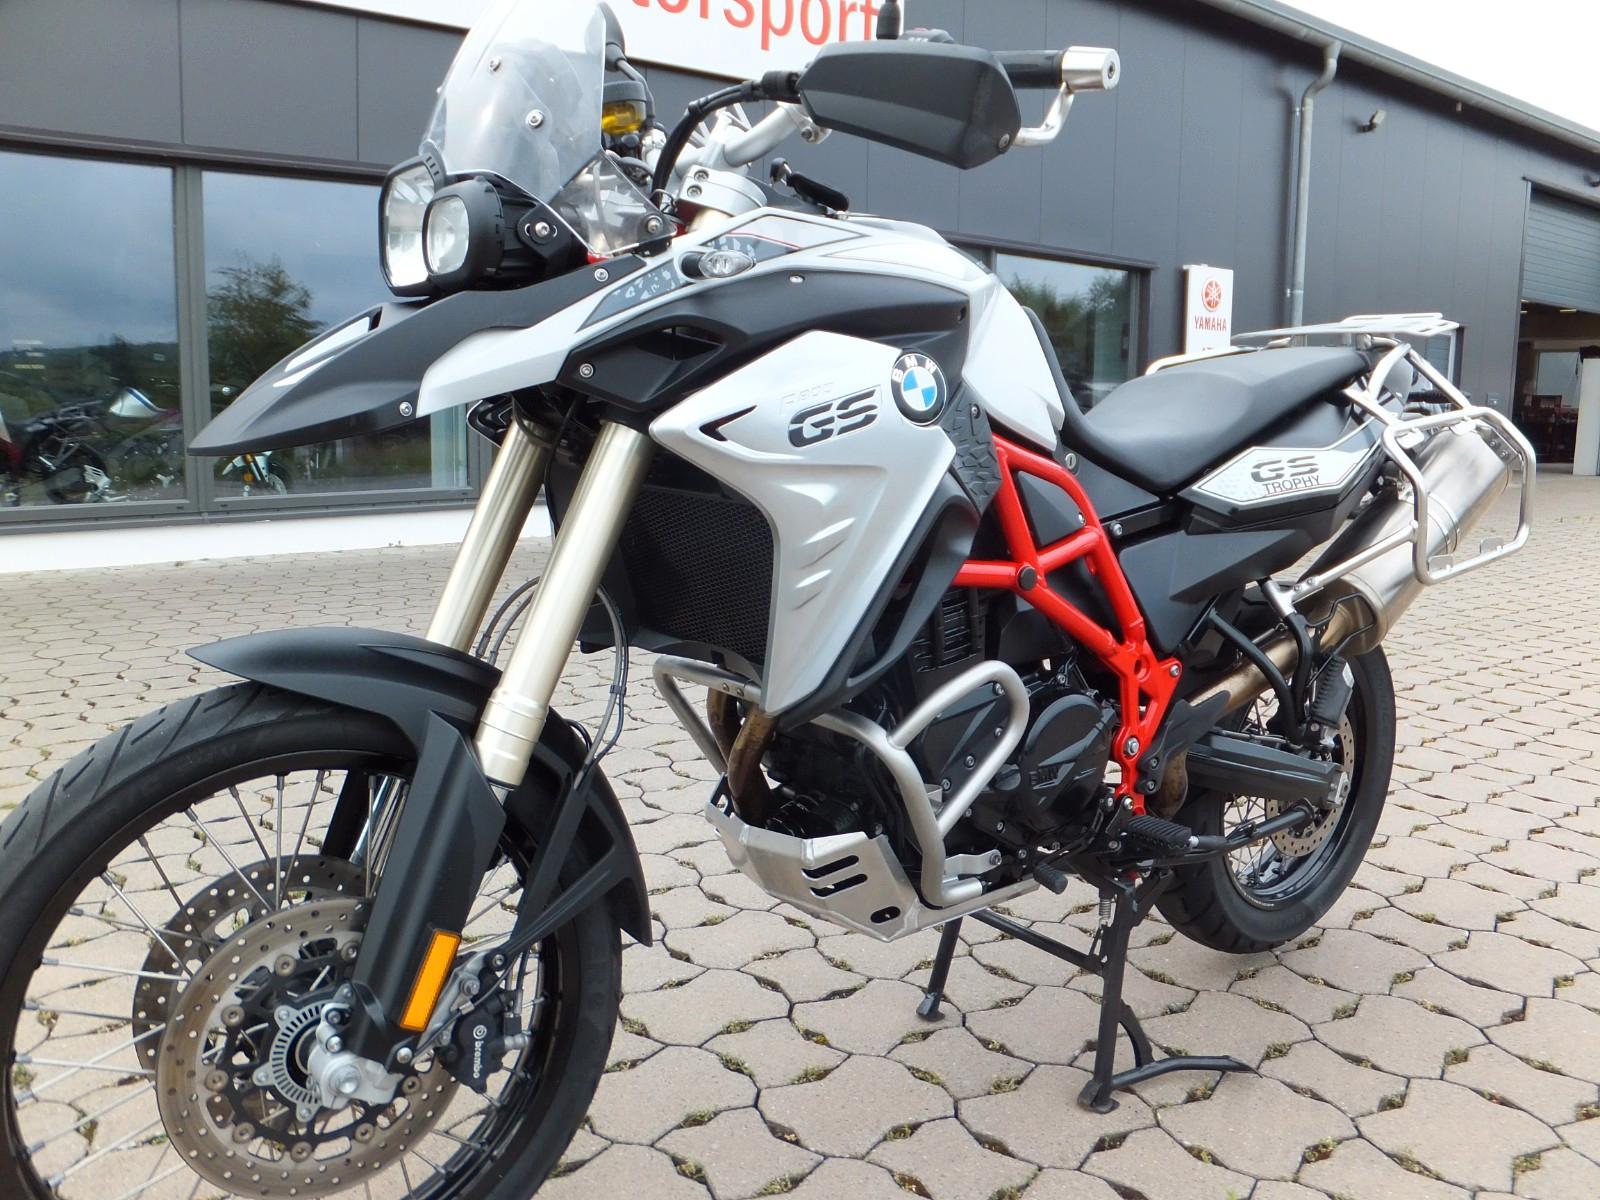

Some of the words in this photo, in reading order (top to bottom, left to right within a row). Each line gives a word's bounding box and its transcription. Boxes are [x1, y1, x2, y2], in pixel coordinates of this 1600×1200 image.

[1194, 315, 1227, 332] YAMAHA
[891, 355, 937, 383] BMW
[788, 388, 878, 448] GS
[1251, 455, 1319, 484] GS
[1263, 475, 1320, 495] TROPHY
[473, 1041, 484, 1078] brembo
